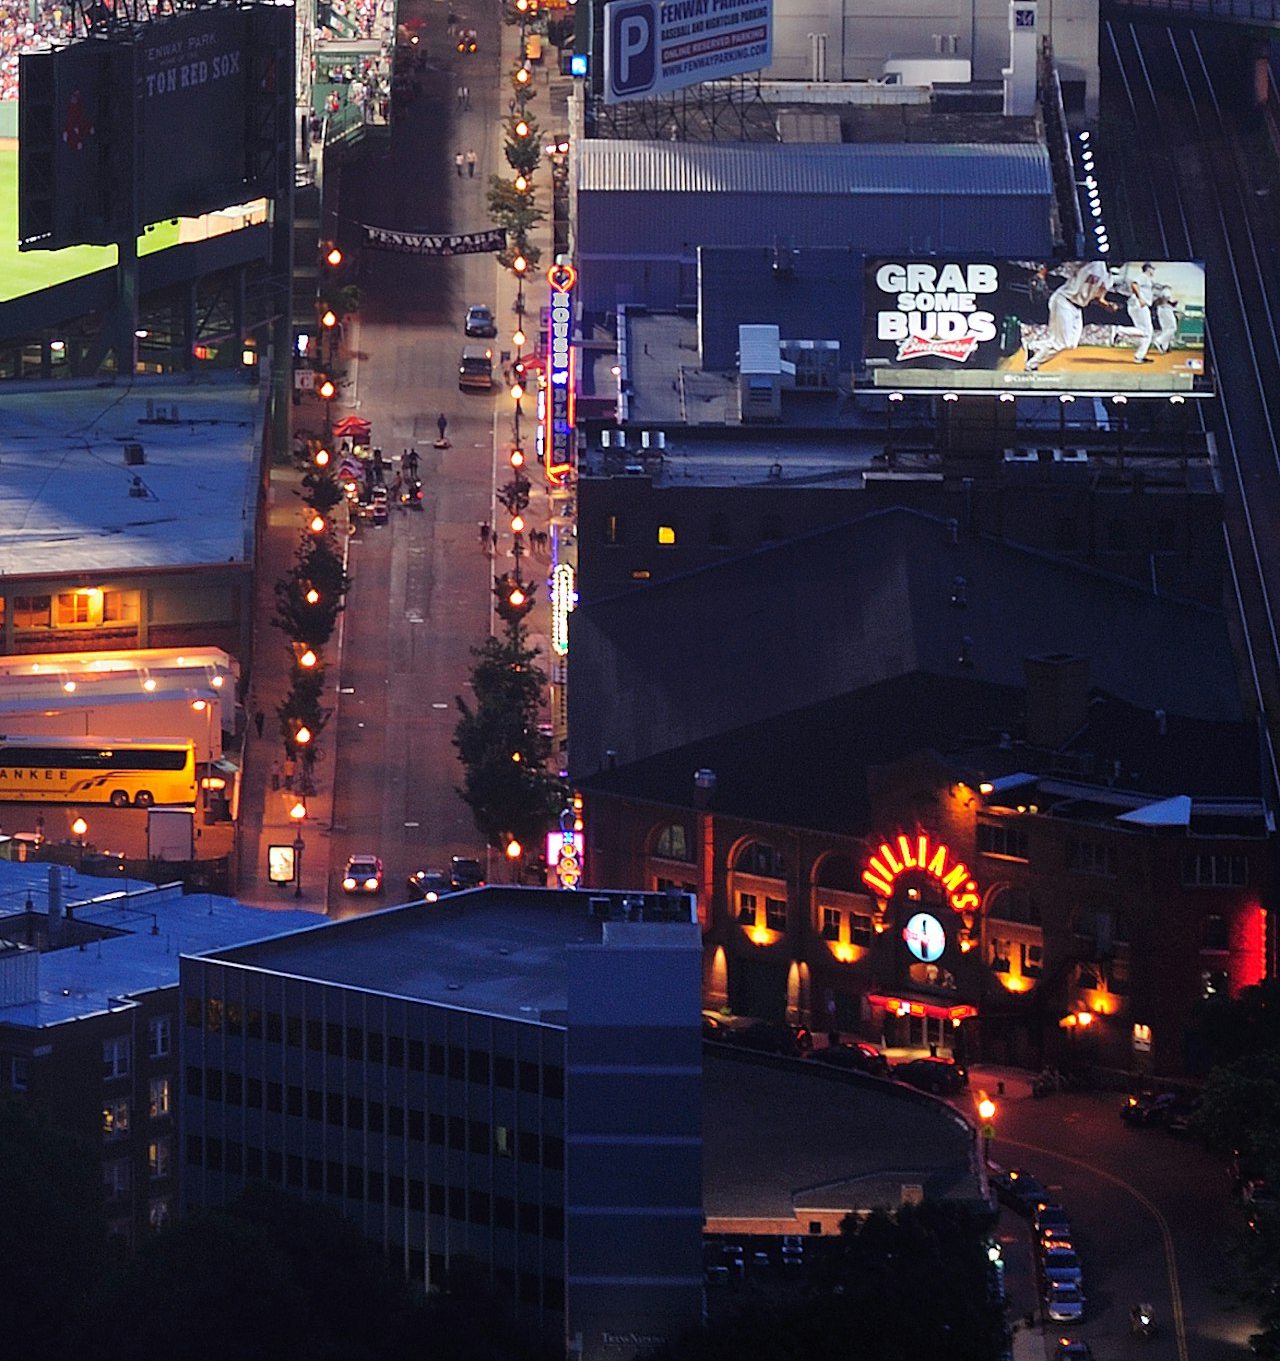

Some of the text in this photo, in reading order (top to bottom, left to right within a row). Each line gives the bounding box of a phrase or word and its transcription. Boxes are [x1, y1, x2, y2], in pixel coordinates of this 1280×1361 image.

[187, 32, 218, 48] PARK
[661, 6, 768, 41] BASEBALL AND NIGHTCLUB PARKING
[620, 15, 650, 83] P
[663, 28, 765, 60] ONLINE RESERVED PARKING
[181, 60, 208, 88] RED
[212, 50, 241, 80] SOX
[662, 43, 768, 79] WWW.FENWAYPARKING.COM
[368, 229, 502, 248] FENWAY PARK
[875, 263, 999, 293] GRAB
[897, 292, 977, 312] SOME
[552, 292, 570, 368] HOUSE
[877, 310, 998, 342] BUDS
[897, 335, 979, 355] Budweiser
[553, 387, 567, 463] BLUES
[862, 834, 982, 912] JILLIAN'S
